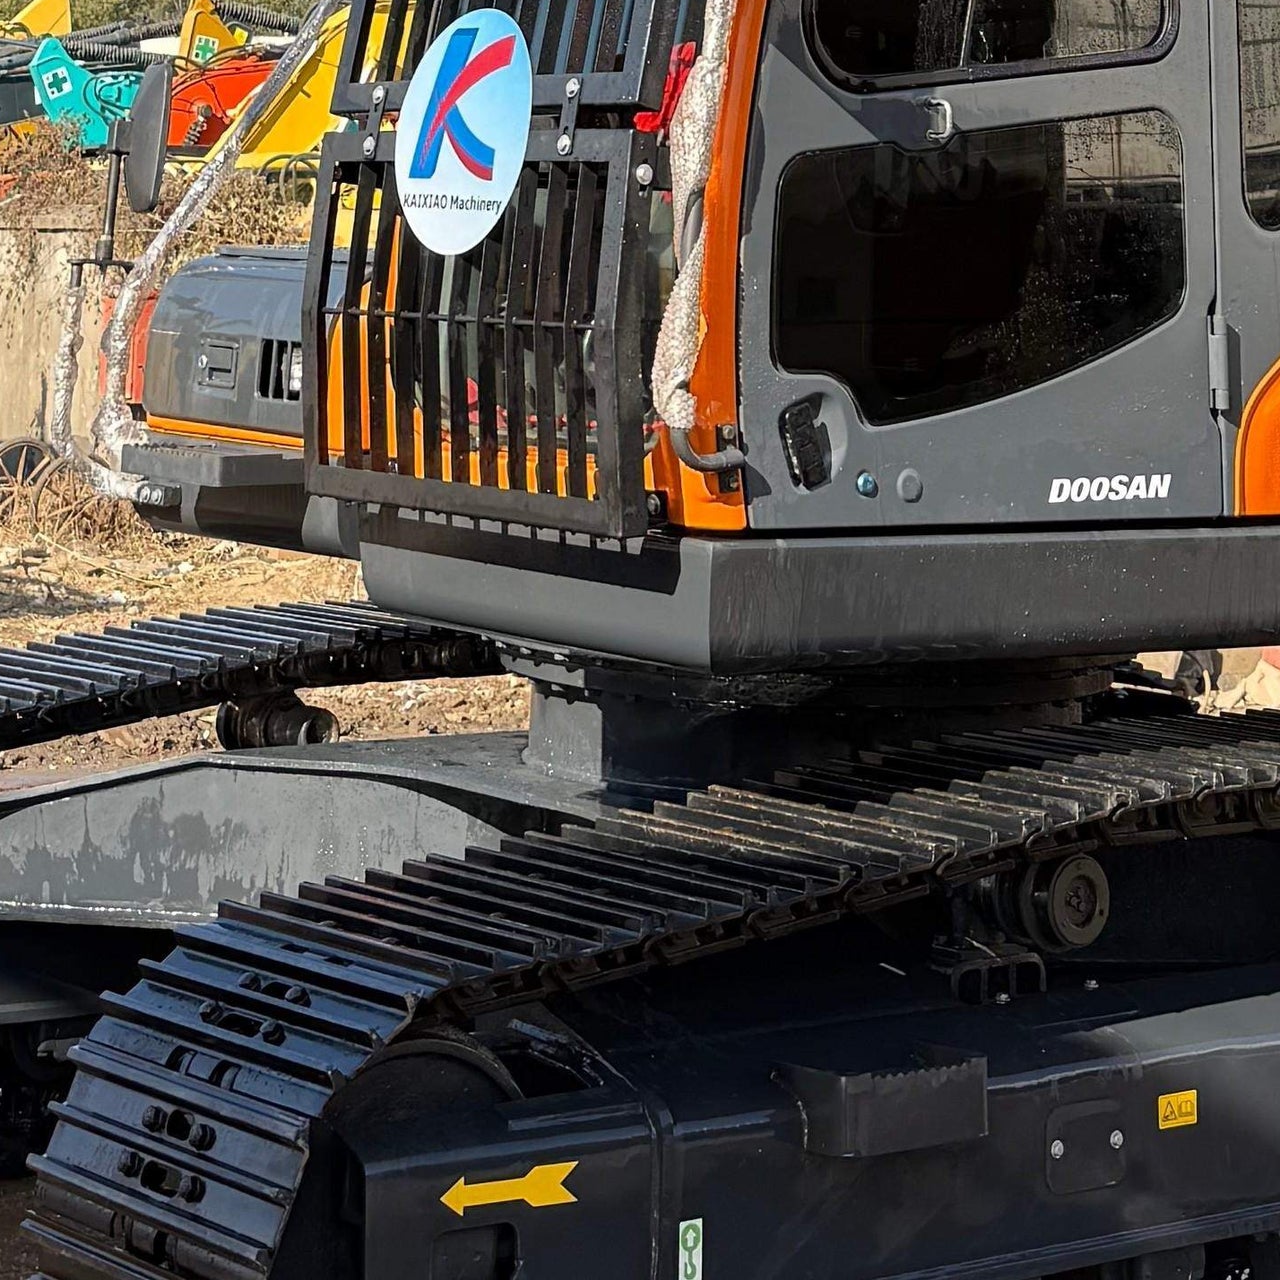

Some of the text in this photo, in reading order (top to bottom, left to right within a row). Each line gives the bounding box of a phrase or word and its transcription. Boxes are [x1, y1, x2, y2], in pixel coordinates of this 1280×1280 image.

[403, 193, 503, 216] KAIXIAO Machinery
[1048, 473, 1172, 504] DOOSAN
